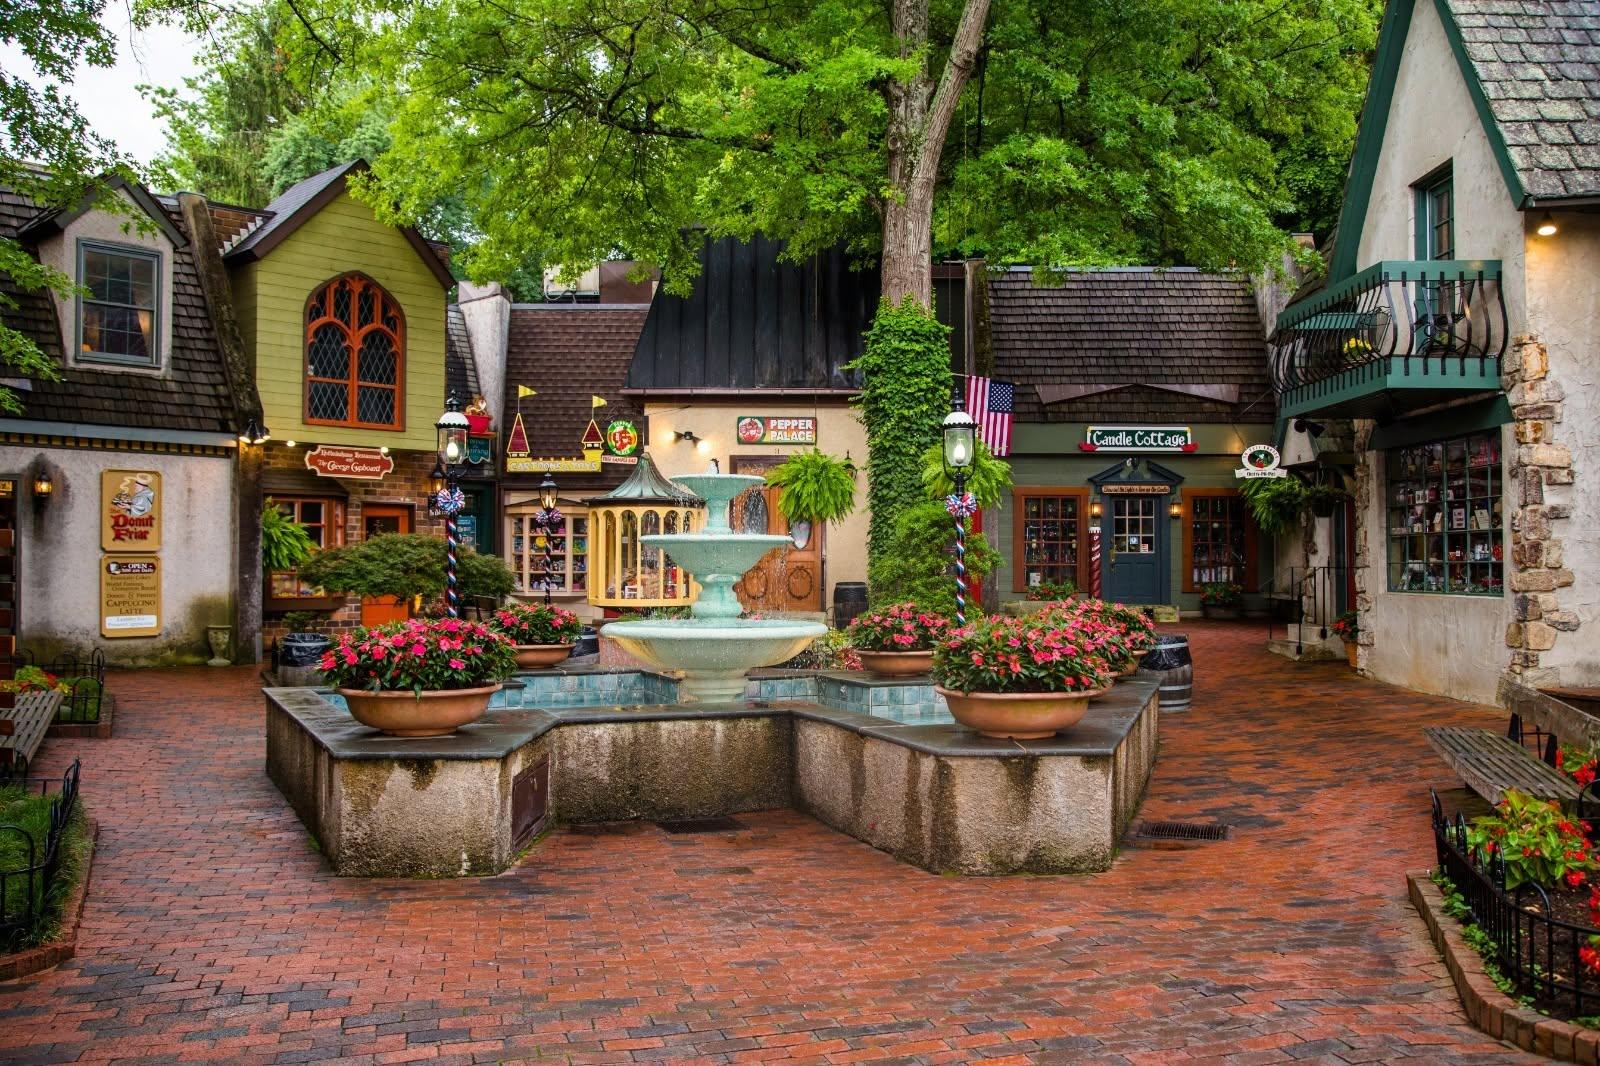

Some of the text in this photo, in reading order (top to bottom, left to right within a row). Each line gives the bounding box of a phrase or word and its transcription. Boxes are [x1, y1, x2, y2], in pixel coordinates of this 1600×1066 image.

[770, 419, 813, 430] PEPPER
[770, 431, 813, 441] PALACE
[1092, 430, 1185, 447] Candle Cottage
[327, 460, 350, 472] Cheese
[351, 462, 381, 473] Cupboard
[511, 461, 561, 471] CARTOONS
[571, 461, 596, 472] TOYS
[111, 513, 155, 528] Donut
[112, 527, 150, 541] Friar
